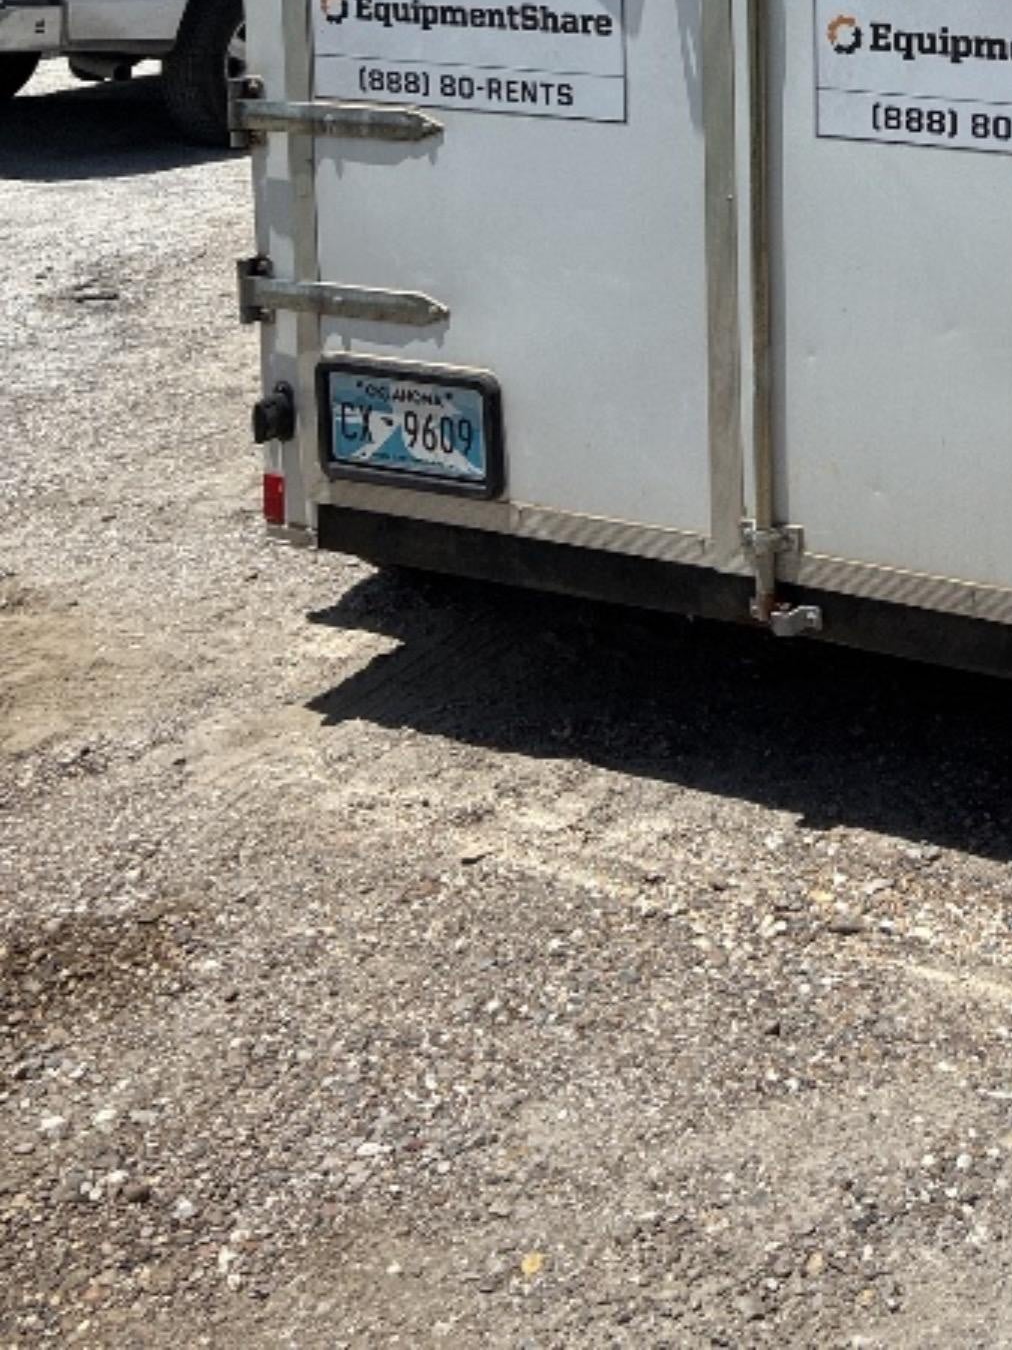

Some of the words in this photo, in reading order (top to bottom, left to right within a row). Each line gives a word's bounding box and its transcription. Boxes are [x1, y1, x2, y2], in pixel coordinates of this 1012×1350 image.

[359, 66, 430, 97] (888)
[440, 74, 574, 106] 80-RENTS
[872, 101, 958, 138] (888)
[404, 410, 474, 457] 9609
